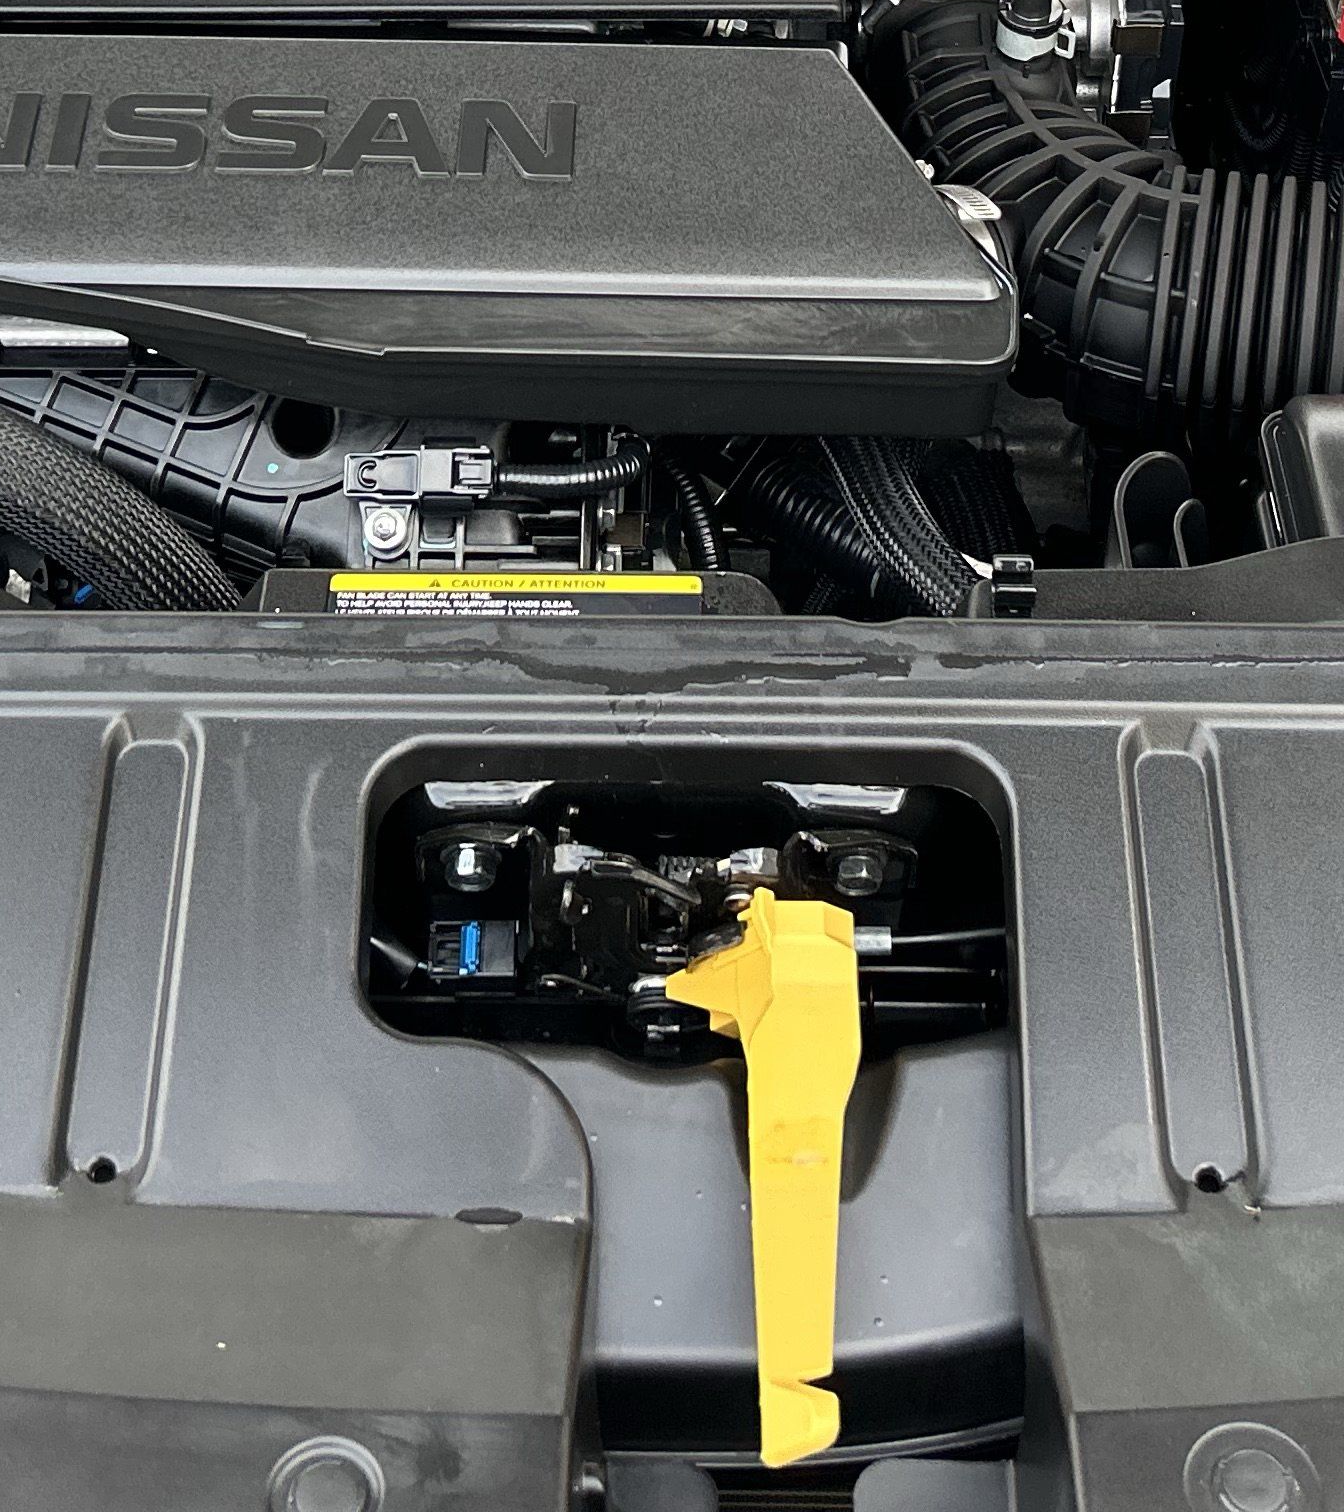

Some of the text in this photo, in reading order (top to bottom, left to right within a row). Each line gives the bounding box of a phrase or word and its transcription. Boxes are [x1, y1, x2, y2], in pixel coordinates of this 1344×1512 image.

[451, 578, 514, 588] CAUTION
[529, 579, 606, 589] ATTENTION
[408, 592, 437, 600] START
[449, 592, 468, 600] ANY
[336, 600, 349, 608] TO
[350, 600, 374, 608] HELP
[375, 600, 402, 608] AVOID
[404, 600, 452, 608] PERSONAL
[508, 600, 540, 608] HANDS
